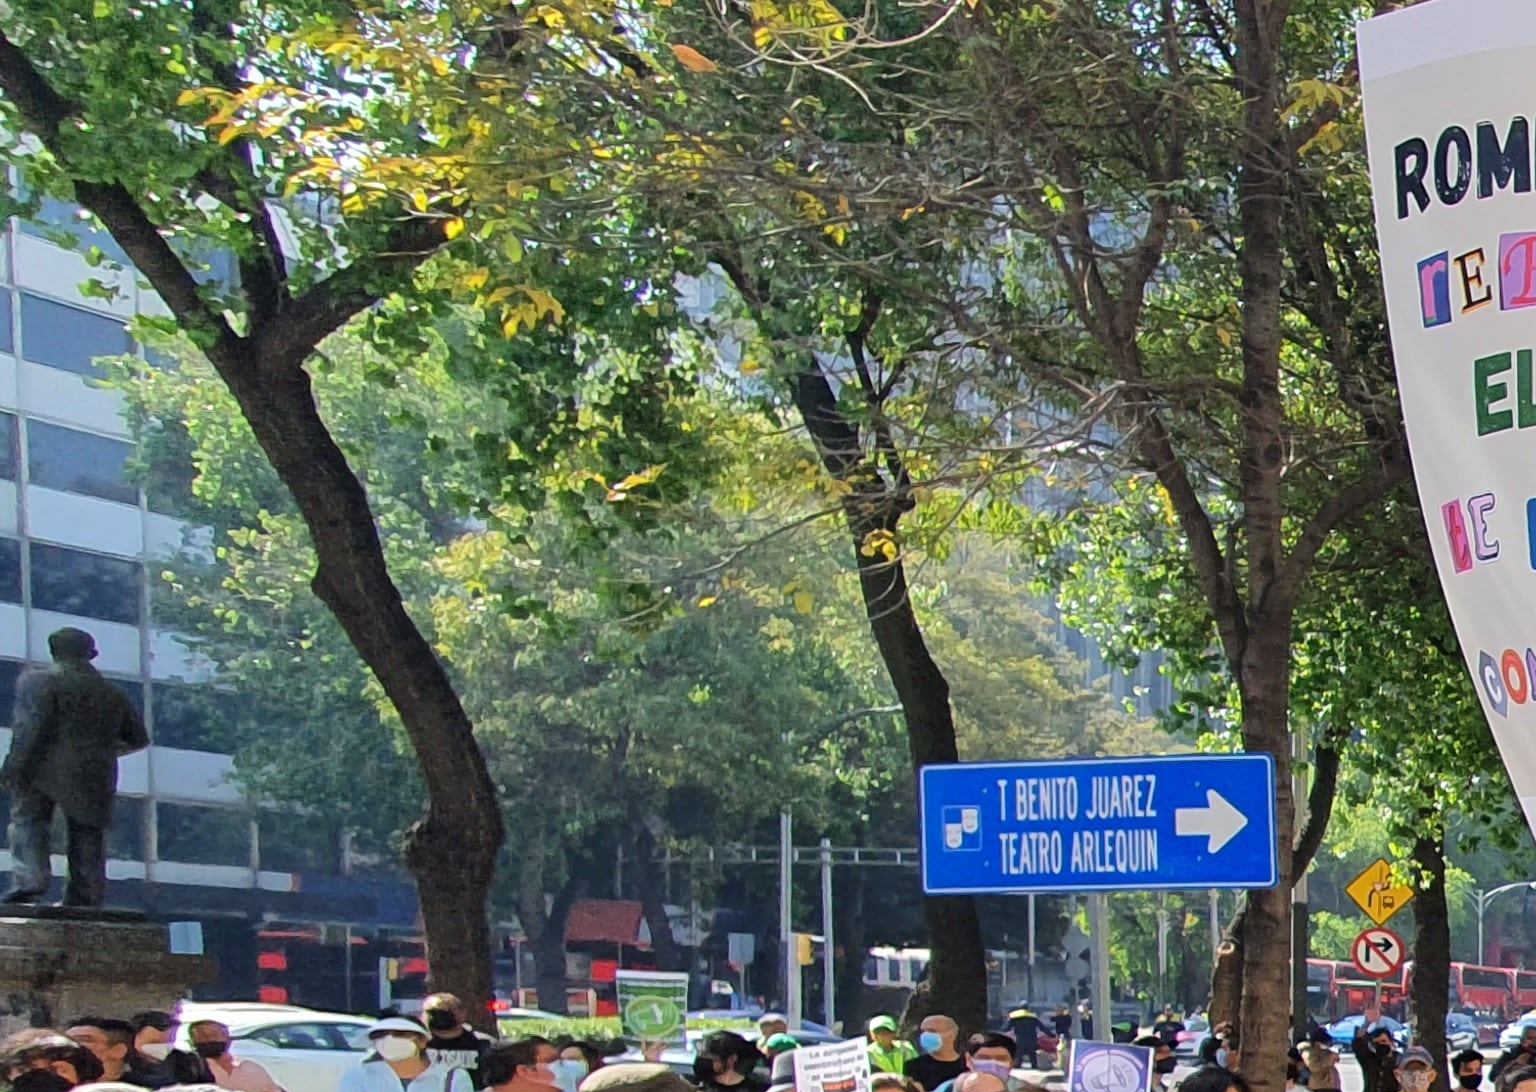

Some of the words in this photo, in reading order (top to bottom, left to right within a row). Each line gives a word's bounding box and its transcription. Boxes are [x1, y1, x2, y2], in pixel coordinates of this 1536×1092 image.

[998, 779, 1008, 821] T
[1015, 776, 1079, 821] BENITO
[1085, 774, 1158, 820] JUAREZ
[999, 833, 1063, 876] TEATRO
[1070, 829, 1159, 874] ARLEQUIN
